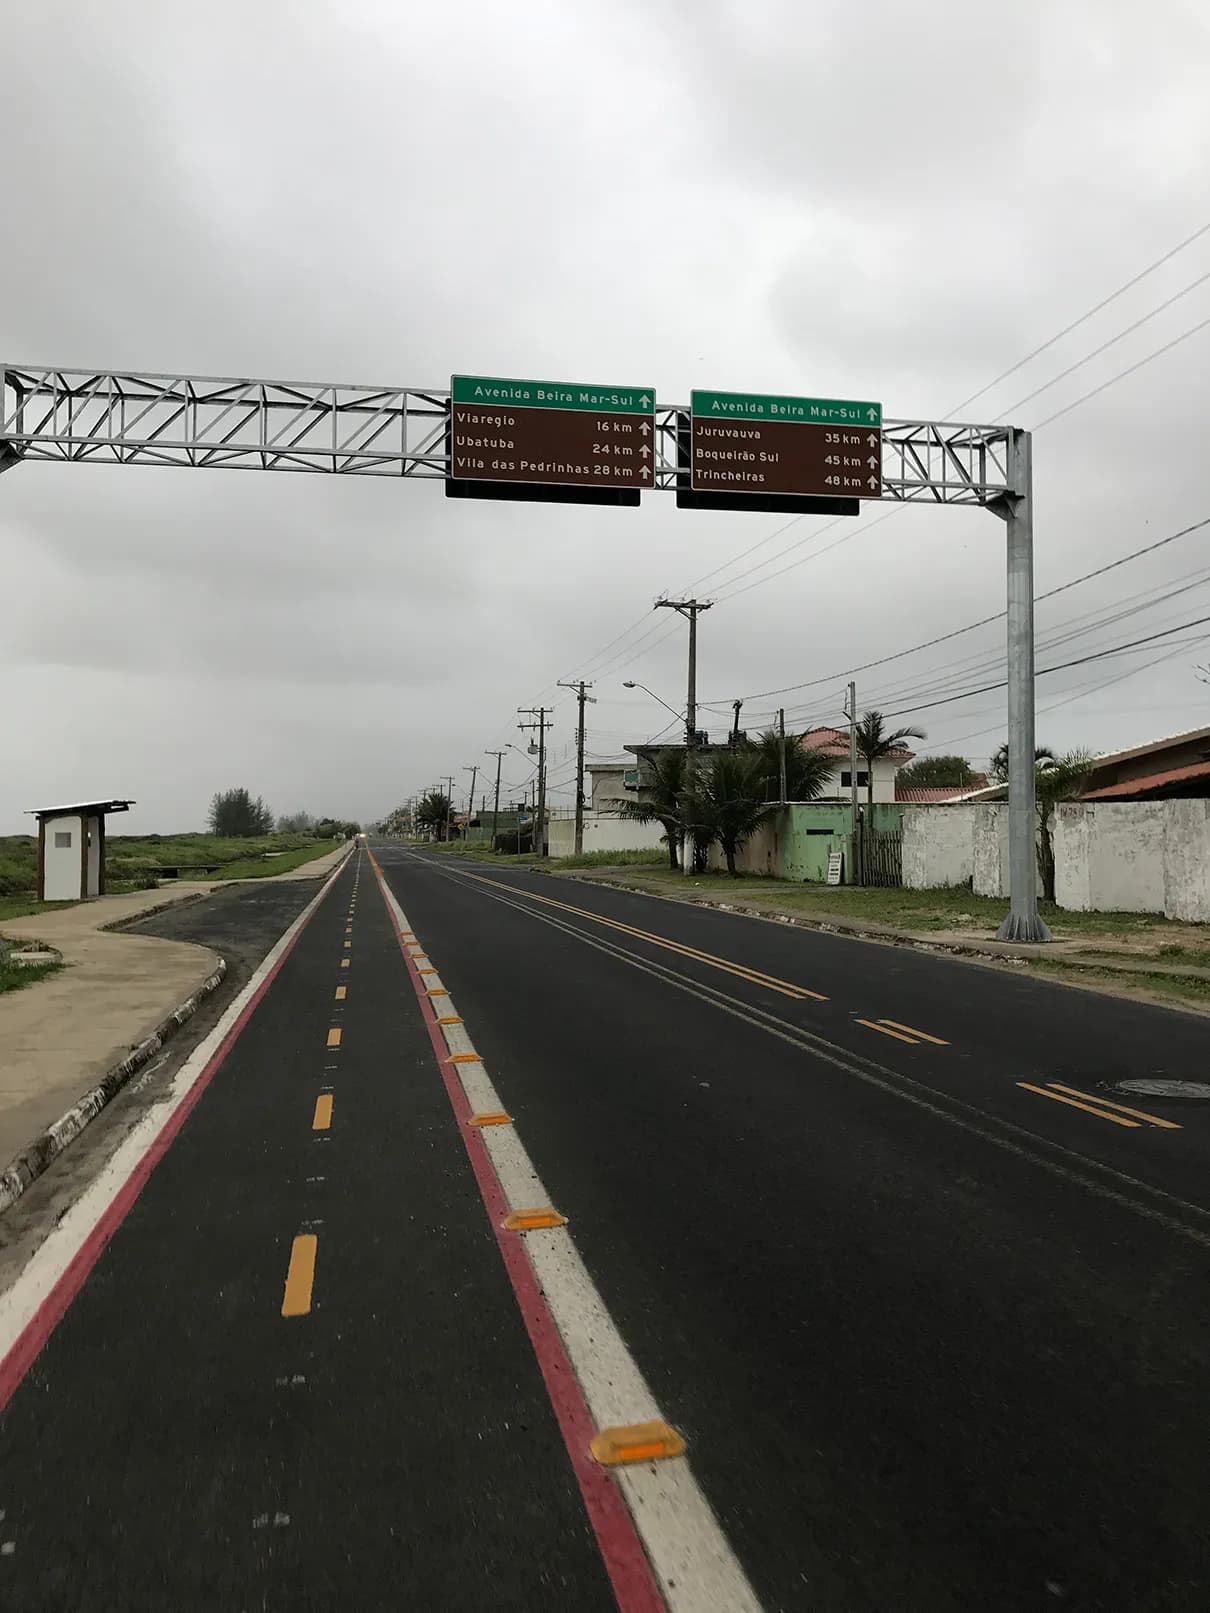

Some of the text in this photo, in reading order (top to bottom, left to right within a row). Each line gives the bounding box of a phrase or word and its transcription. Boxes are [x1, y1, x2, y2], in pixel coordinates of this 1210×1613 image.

[474, 386, 633, 406] Avenida Beira Mar-Sul
[711, 400, 861, 418] Avenida Beira Mar-Sul
[457, 412, 632, 433] Viaregio 16 km
[456, 435, 633, 455] Ubatuba 24 km
[824, 433, 840, 443] 35
[843, 434, 861, 445] km
[457, 457, 633, 477] Vila das Pedrinhas 28 km
[696, 448, 861, 467] Boqueirão Sul 45 km
[696, 469, 861, 487] Trincheiras 48 km
